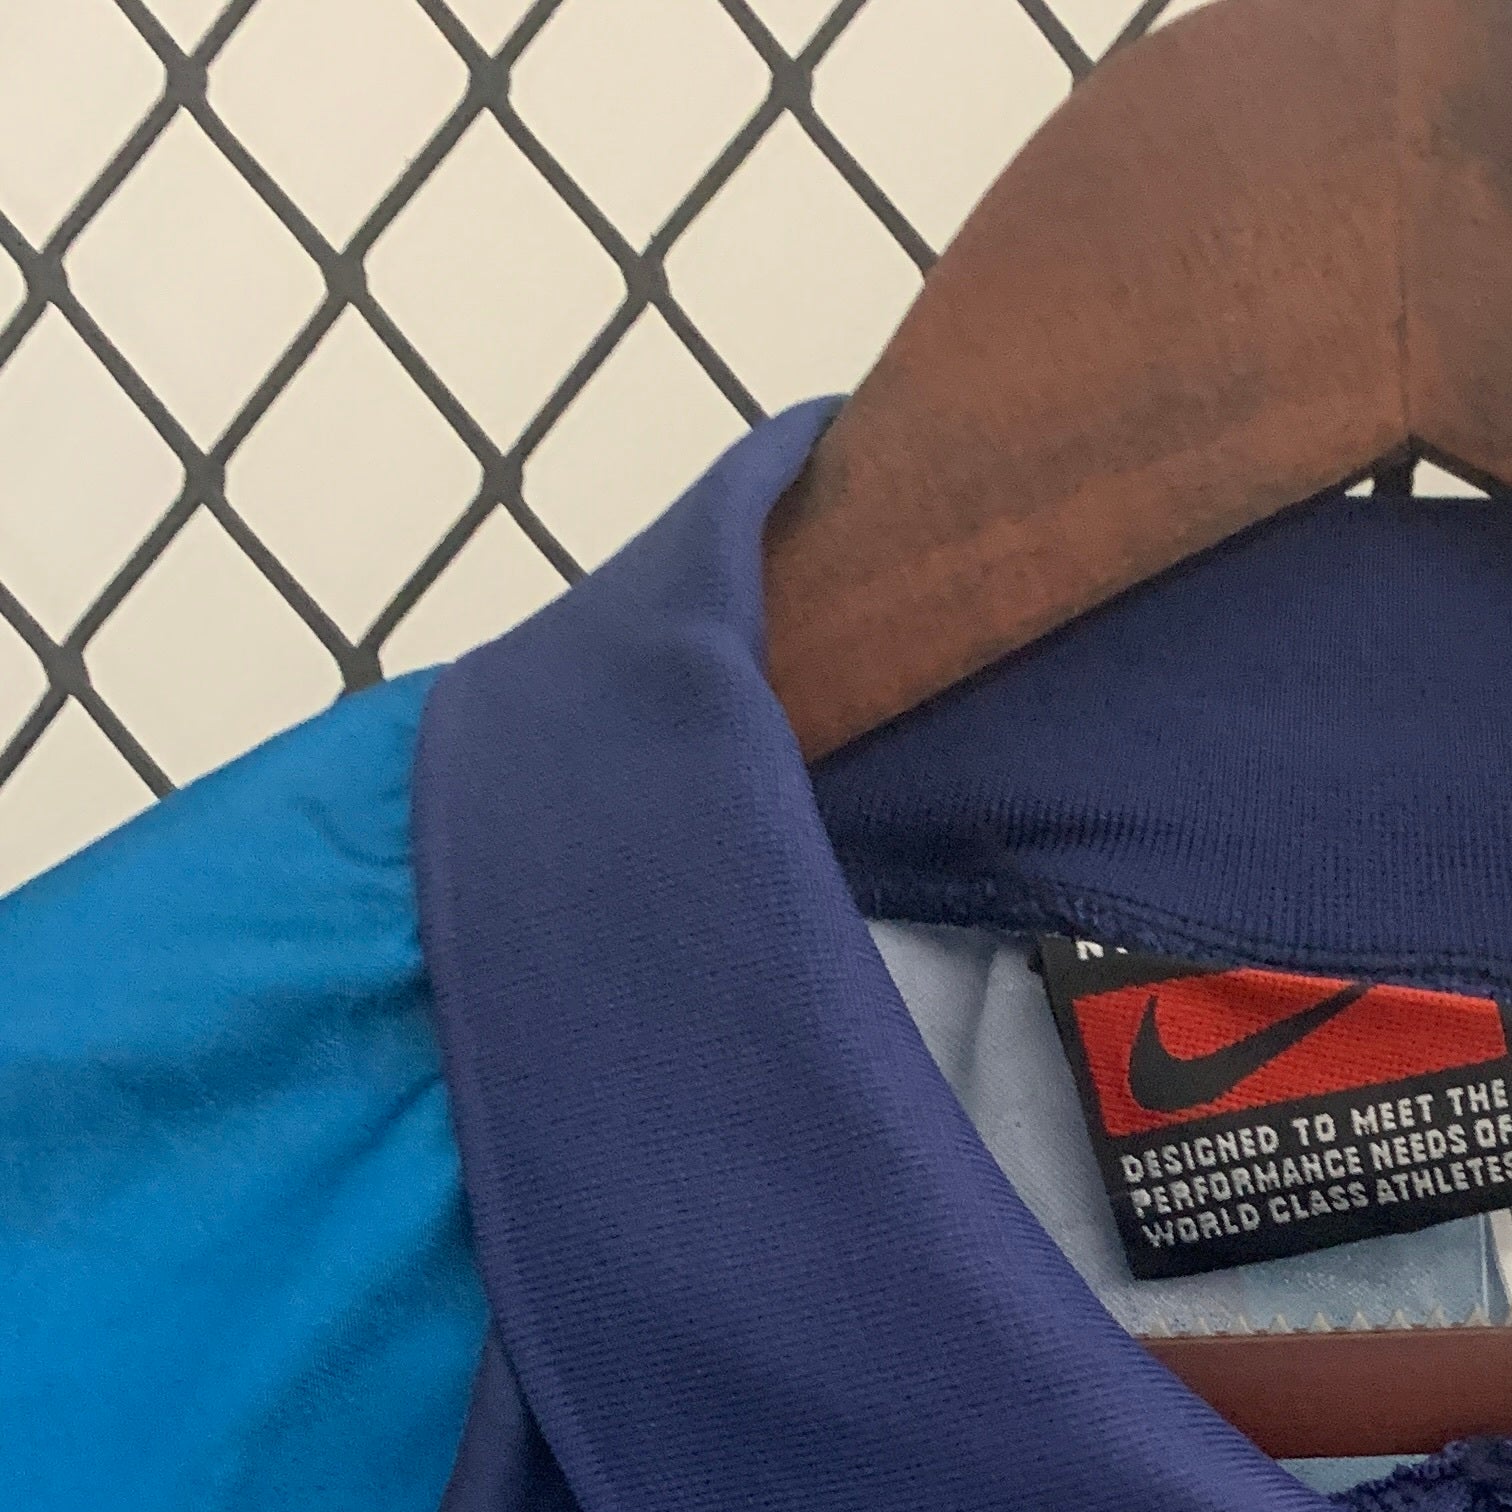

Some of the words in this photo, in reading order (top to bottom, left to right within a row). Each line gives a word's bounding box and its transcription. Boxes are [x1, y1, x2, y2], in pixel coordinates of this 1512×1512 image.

[1121, 1125, 1279, 1183] DESIGNED
[1291, 1114, 1337, 1147] TO
[1350, 1094, 1434, 1137] MEET
[1446, 1079, 1509, 1116] THE
[1131, 1147, 1363, 1218] PERFORMANCE
[1369, 1125, 1467, 1171] NEEDS
[1474, 1115, 1512, 1147] OF
[1141, 1203, 1260, 1248] WORLD
[1269, 1183, 1369, 1225] CLASS
